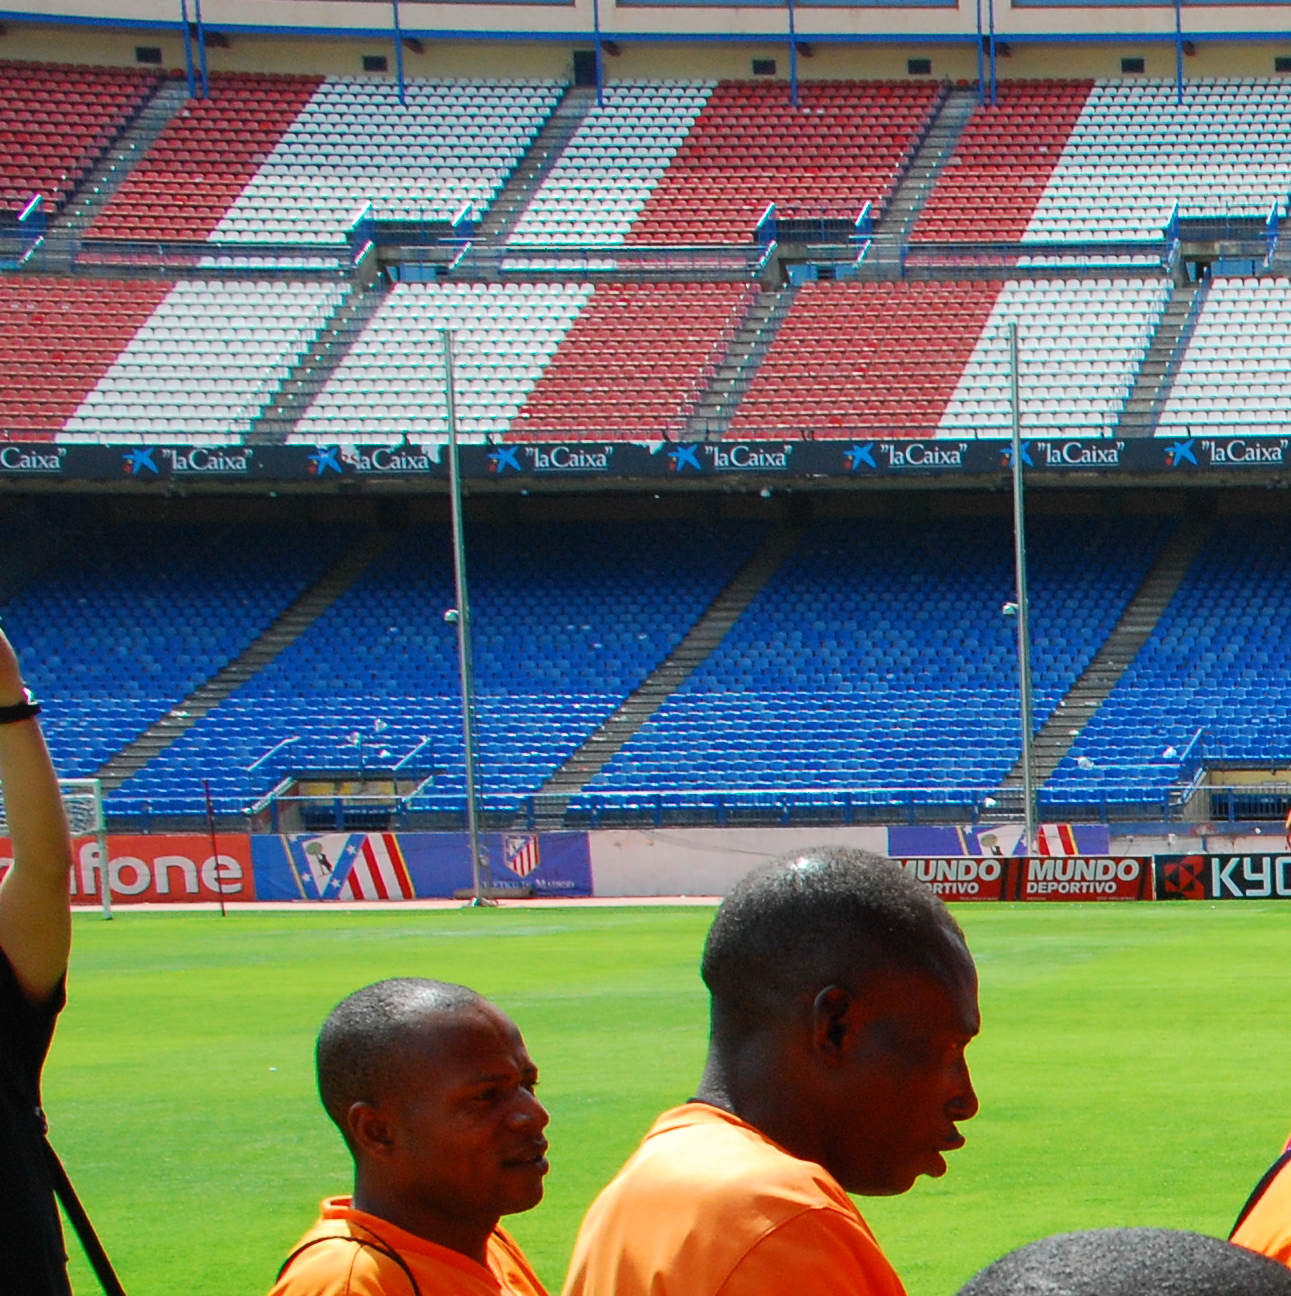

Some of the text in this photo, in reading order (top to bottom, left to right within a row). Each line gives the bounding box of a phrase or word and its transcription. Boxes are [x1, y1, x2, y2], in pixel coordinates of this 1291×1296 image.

[70, 842, 243, 896] fone
[1027, 859, 1140, 881] MUNDO
[1026, 881, 1118, 895] DEPORTIVO
